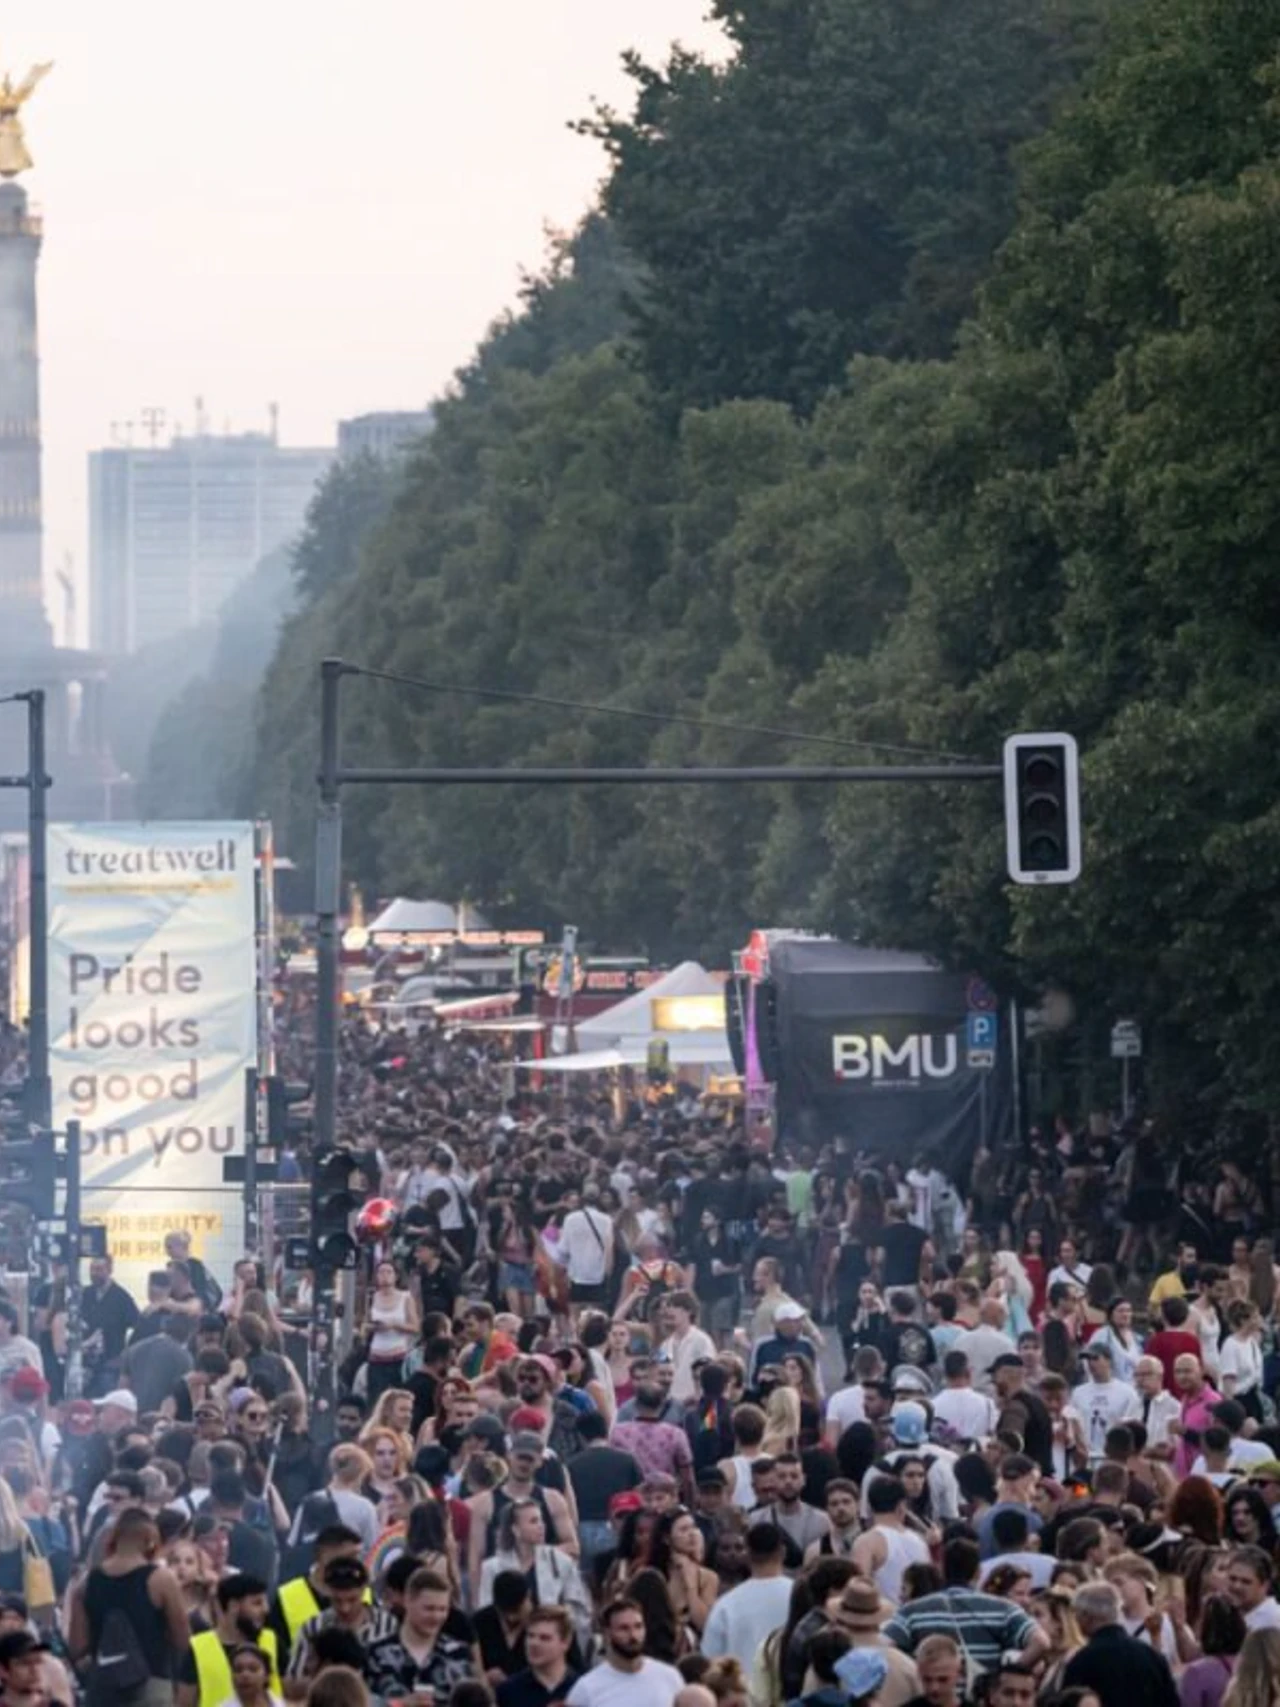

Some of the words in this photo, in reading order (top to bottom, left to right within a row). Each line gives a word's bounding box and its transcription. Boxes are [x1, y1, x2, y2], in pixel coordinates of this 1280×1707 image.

[65, 840, 236, 875] treatwell
[70, 951, 202, 996] Pride
[70, 1006, 200, 1050] looks
[974, 1016, 990, 1043] P
[832, 1033, 957, 1079] BMU
[69, 1058, 198, 1116] good
[147, 1125, 235, 1169] you
